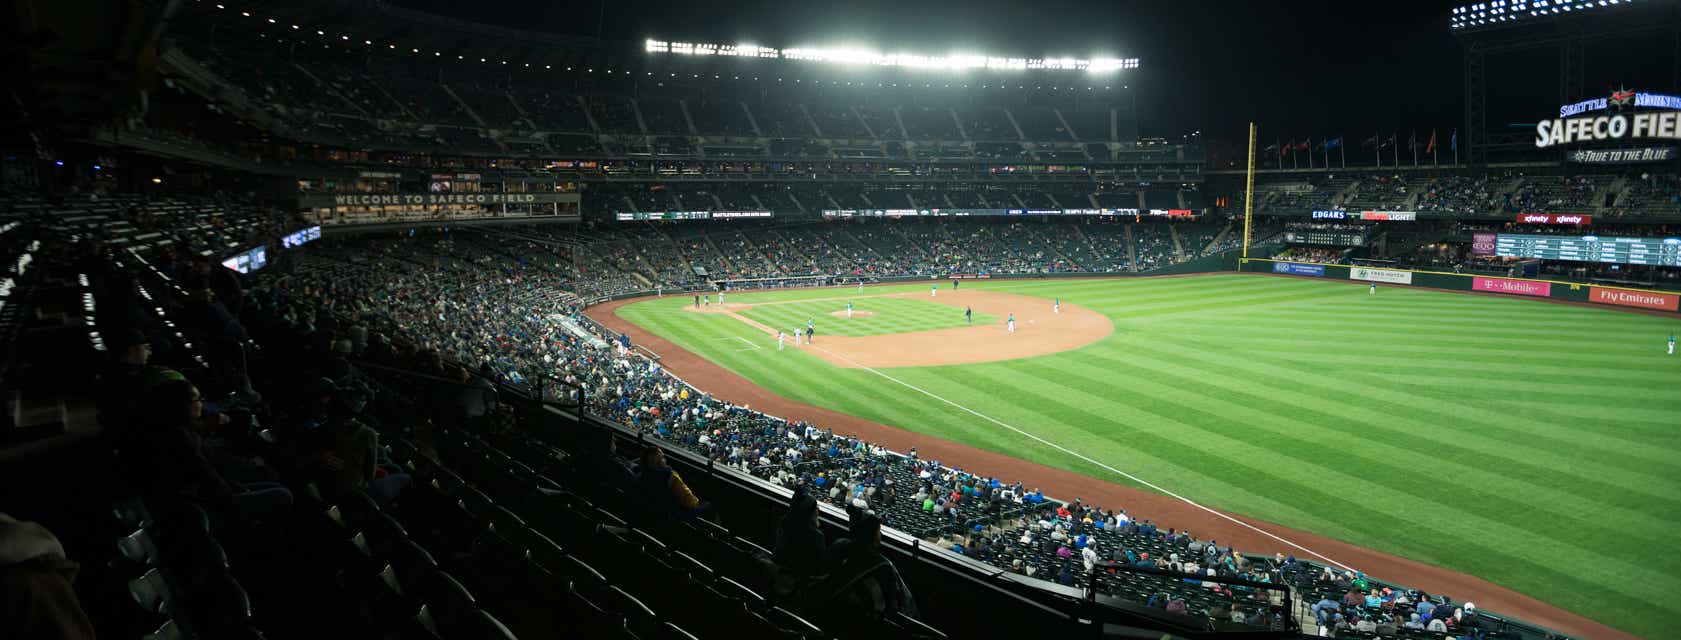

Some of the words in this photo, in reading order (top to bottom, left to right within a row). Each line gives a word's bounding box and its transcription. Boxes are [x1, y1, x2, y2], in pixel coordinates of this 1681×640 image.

[1560, 98, 1607, 117] SEATTLE
[1536, 116, 1627, 147] SAFECO
[1585, 150, 1607, 162] TRUE
[1610, 151, 1622, 161] TO
[1624, 150, 1641, 161] THE
[1642, 148, 1668, 160] BLUE
[335, 194, 399, 204] WELCOME
[405, 194, 423, 203] TO
[430, 193, 486, 203] SAFECO
[493, 193, 535, 203] FIELD
[1525, 215, 1549, 223] xfinity
[1556, 216, 1582, 224] xfinity
[1601, 291, 1618, 302] Fly
[1620, 292, 1665, 306] Emirates
